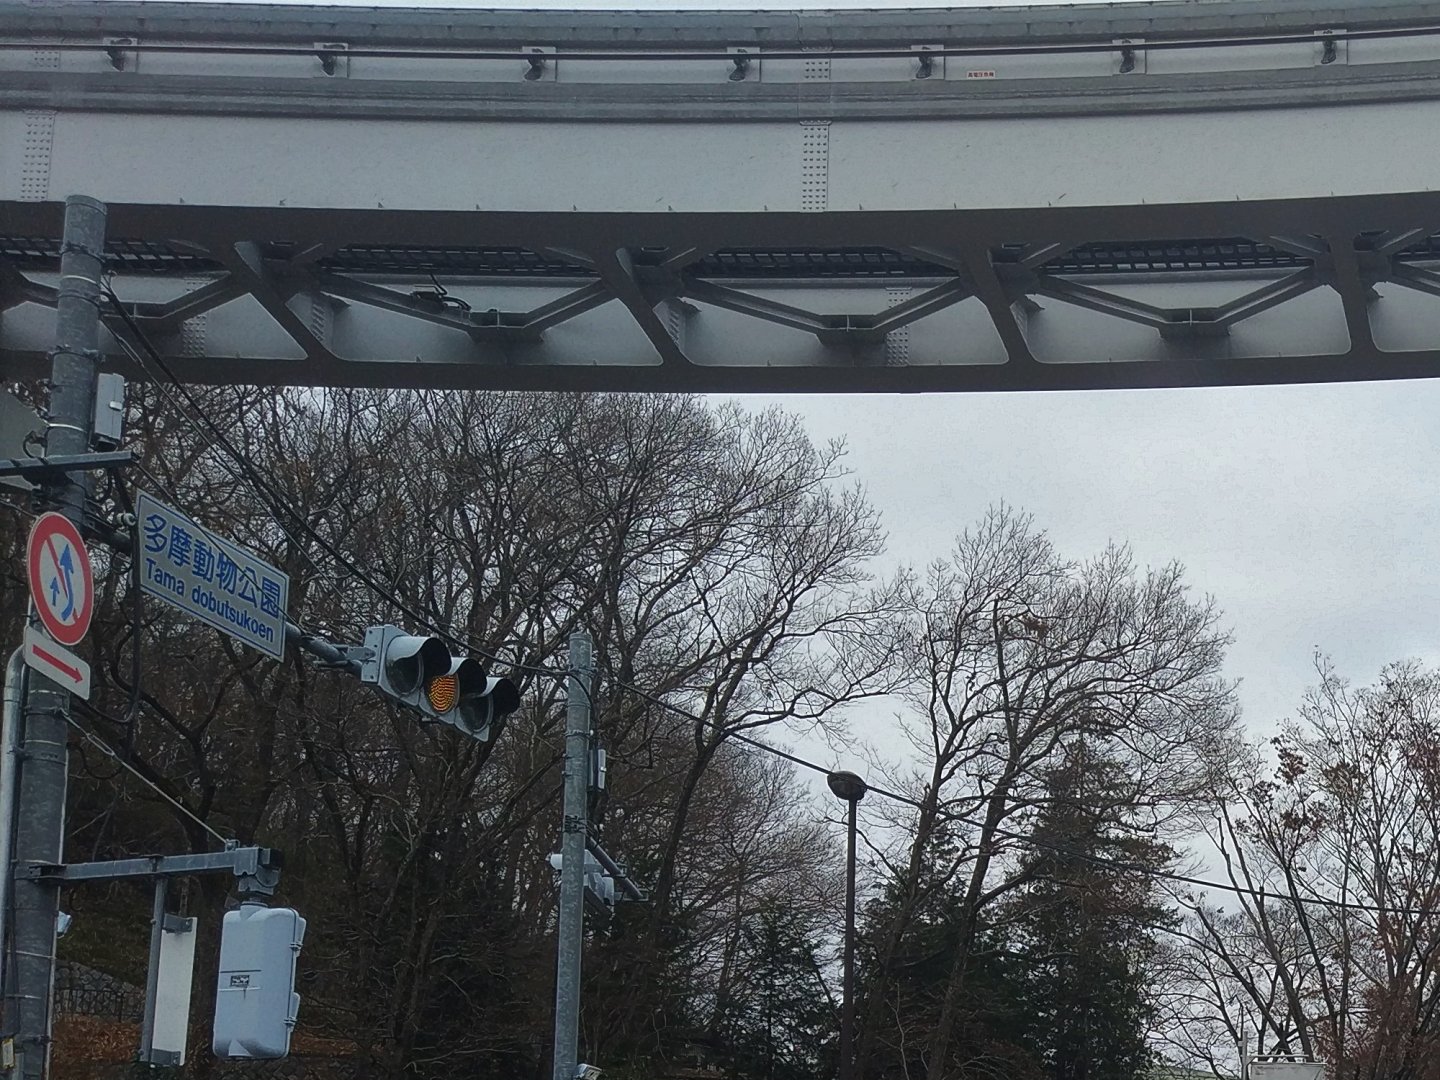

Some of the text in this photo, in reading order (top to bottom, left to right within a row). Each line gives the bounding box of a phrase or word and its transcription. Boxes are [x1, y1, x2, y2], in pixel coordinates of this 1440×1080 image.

[144, 514, 281, 619] 多摩動物公園
[146, 557, 274, 643] Tama dobutsukoen
